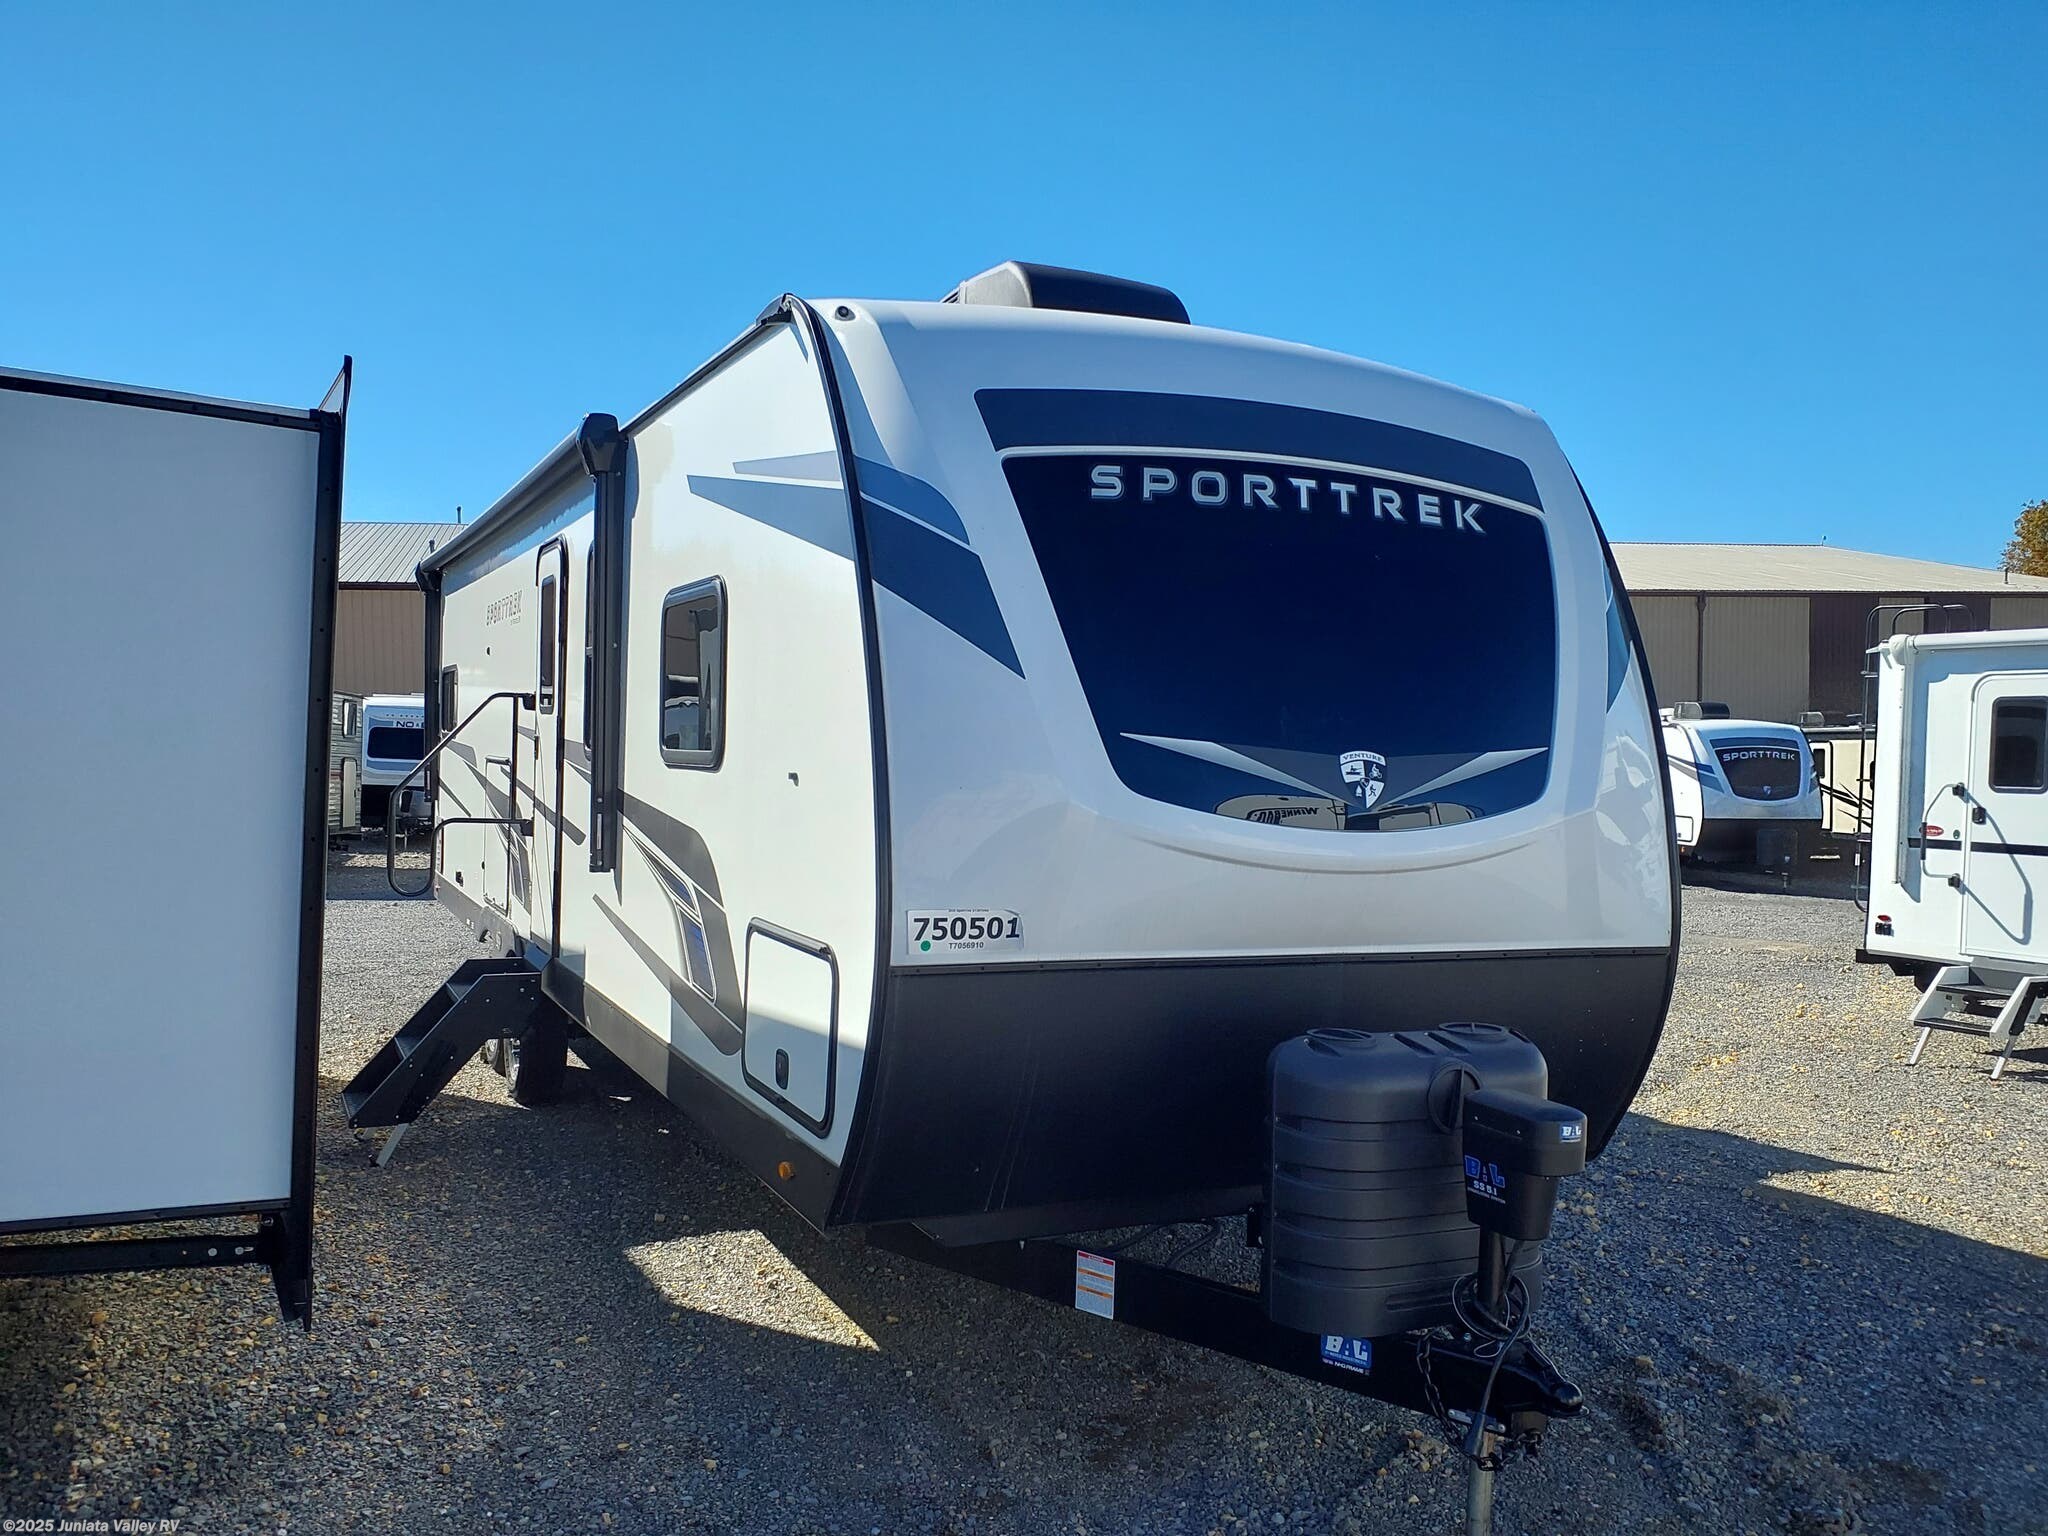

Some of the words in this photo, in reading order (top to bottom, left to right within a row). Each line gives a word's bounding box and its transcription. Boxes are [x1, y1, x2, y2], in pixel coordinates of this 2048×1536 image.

[1090, 464, 1486, 534] SPORTTREK
[1342, 752, 1383, 762] VENTURE
[1722, 750, 1795, 761] SPORTTREK
[913, 916, 1020, 941] 750501
[948, 941, 984, 950] T7056910
